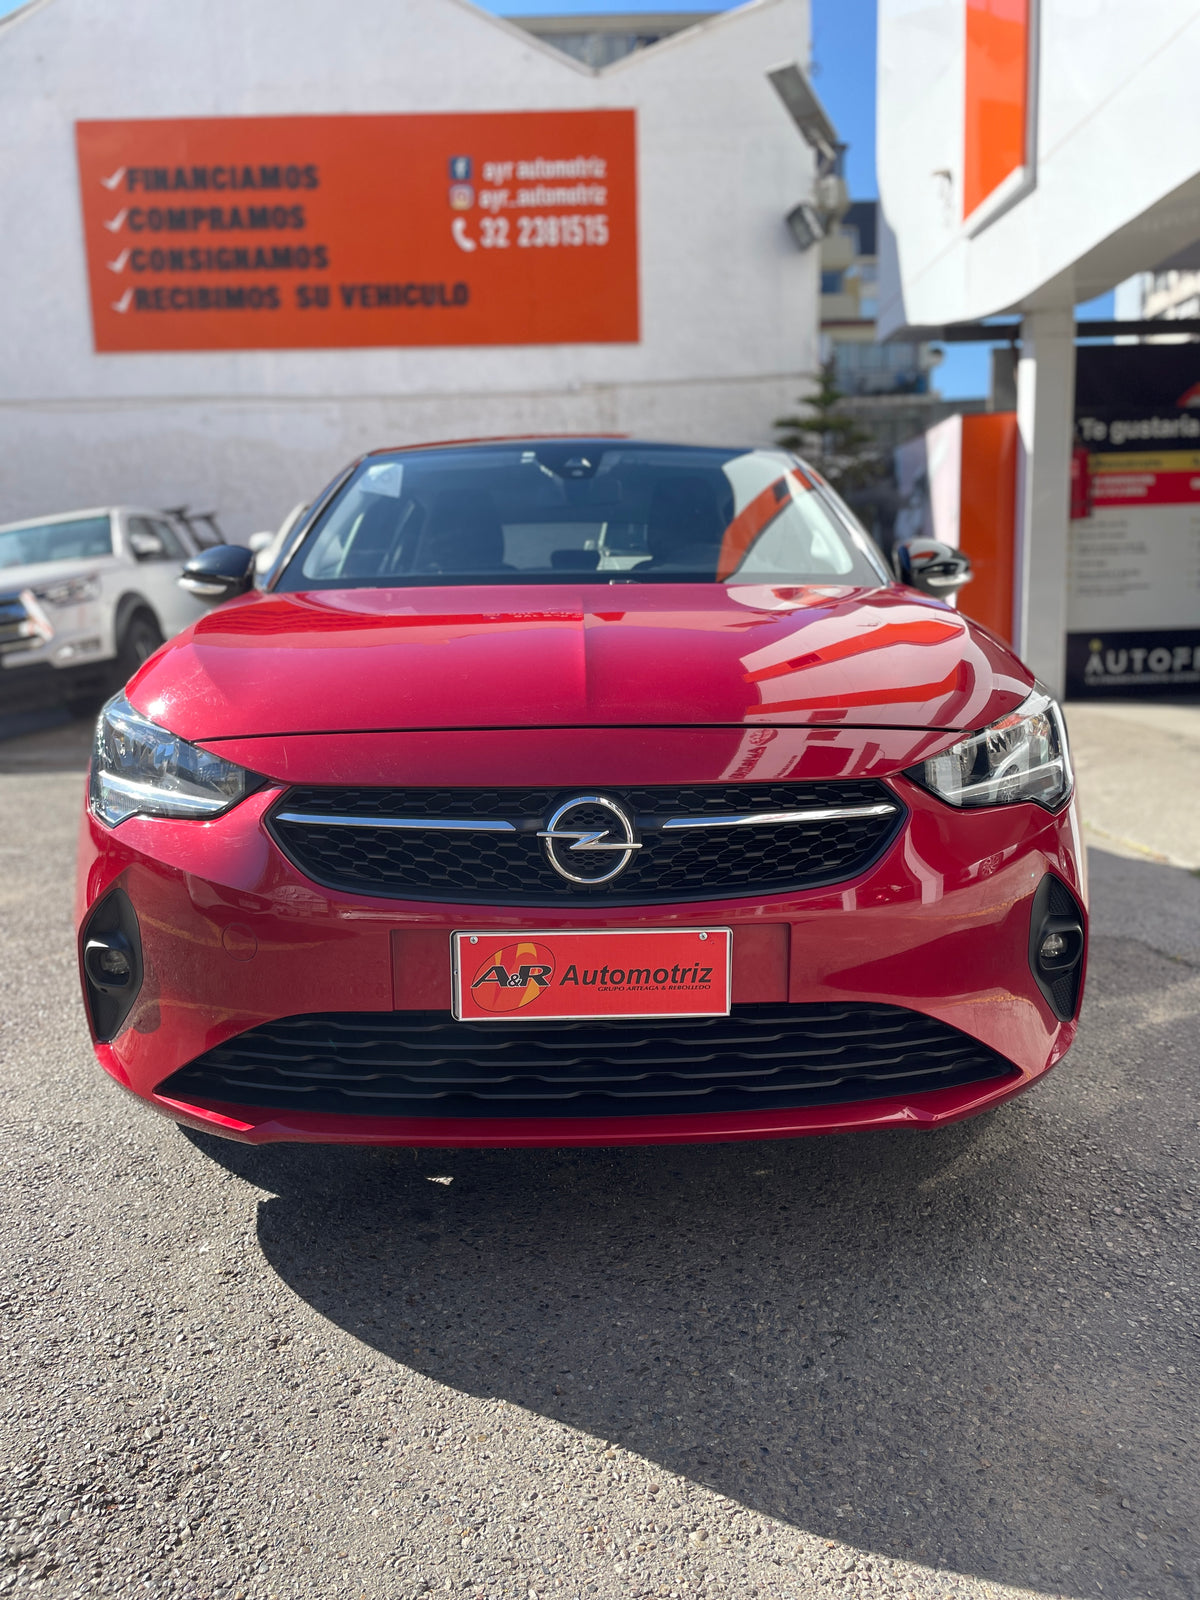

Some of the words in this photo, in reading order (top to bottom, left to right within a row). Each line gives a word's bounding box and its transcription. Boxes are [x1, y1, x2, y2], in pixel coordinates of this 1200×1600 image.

[126, 165, 319, 192] FINANCIAMOS
[483, 161, 513, 185] ayr
[517, 156, 607, 180] automotriz
[127, 206, 305, 231] COMPRAMOS
[480, 216, 510, 248] 32
[517, 214, 609, 247] 2381515
[130, 246, 329, 272] CONSIGNAMOS
[134, 285, 281, 312] RECIBIMOS
[296, 284, 331, 309] SU
[339, 282, 470, 309] VEHICULO
[1079, 417, 1107, 441] Te
[471, 965, 552, 988] A&R
[560, 962, 713, 986] Automotriz
